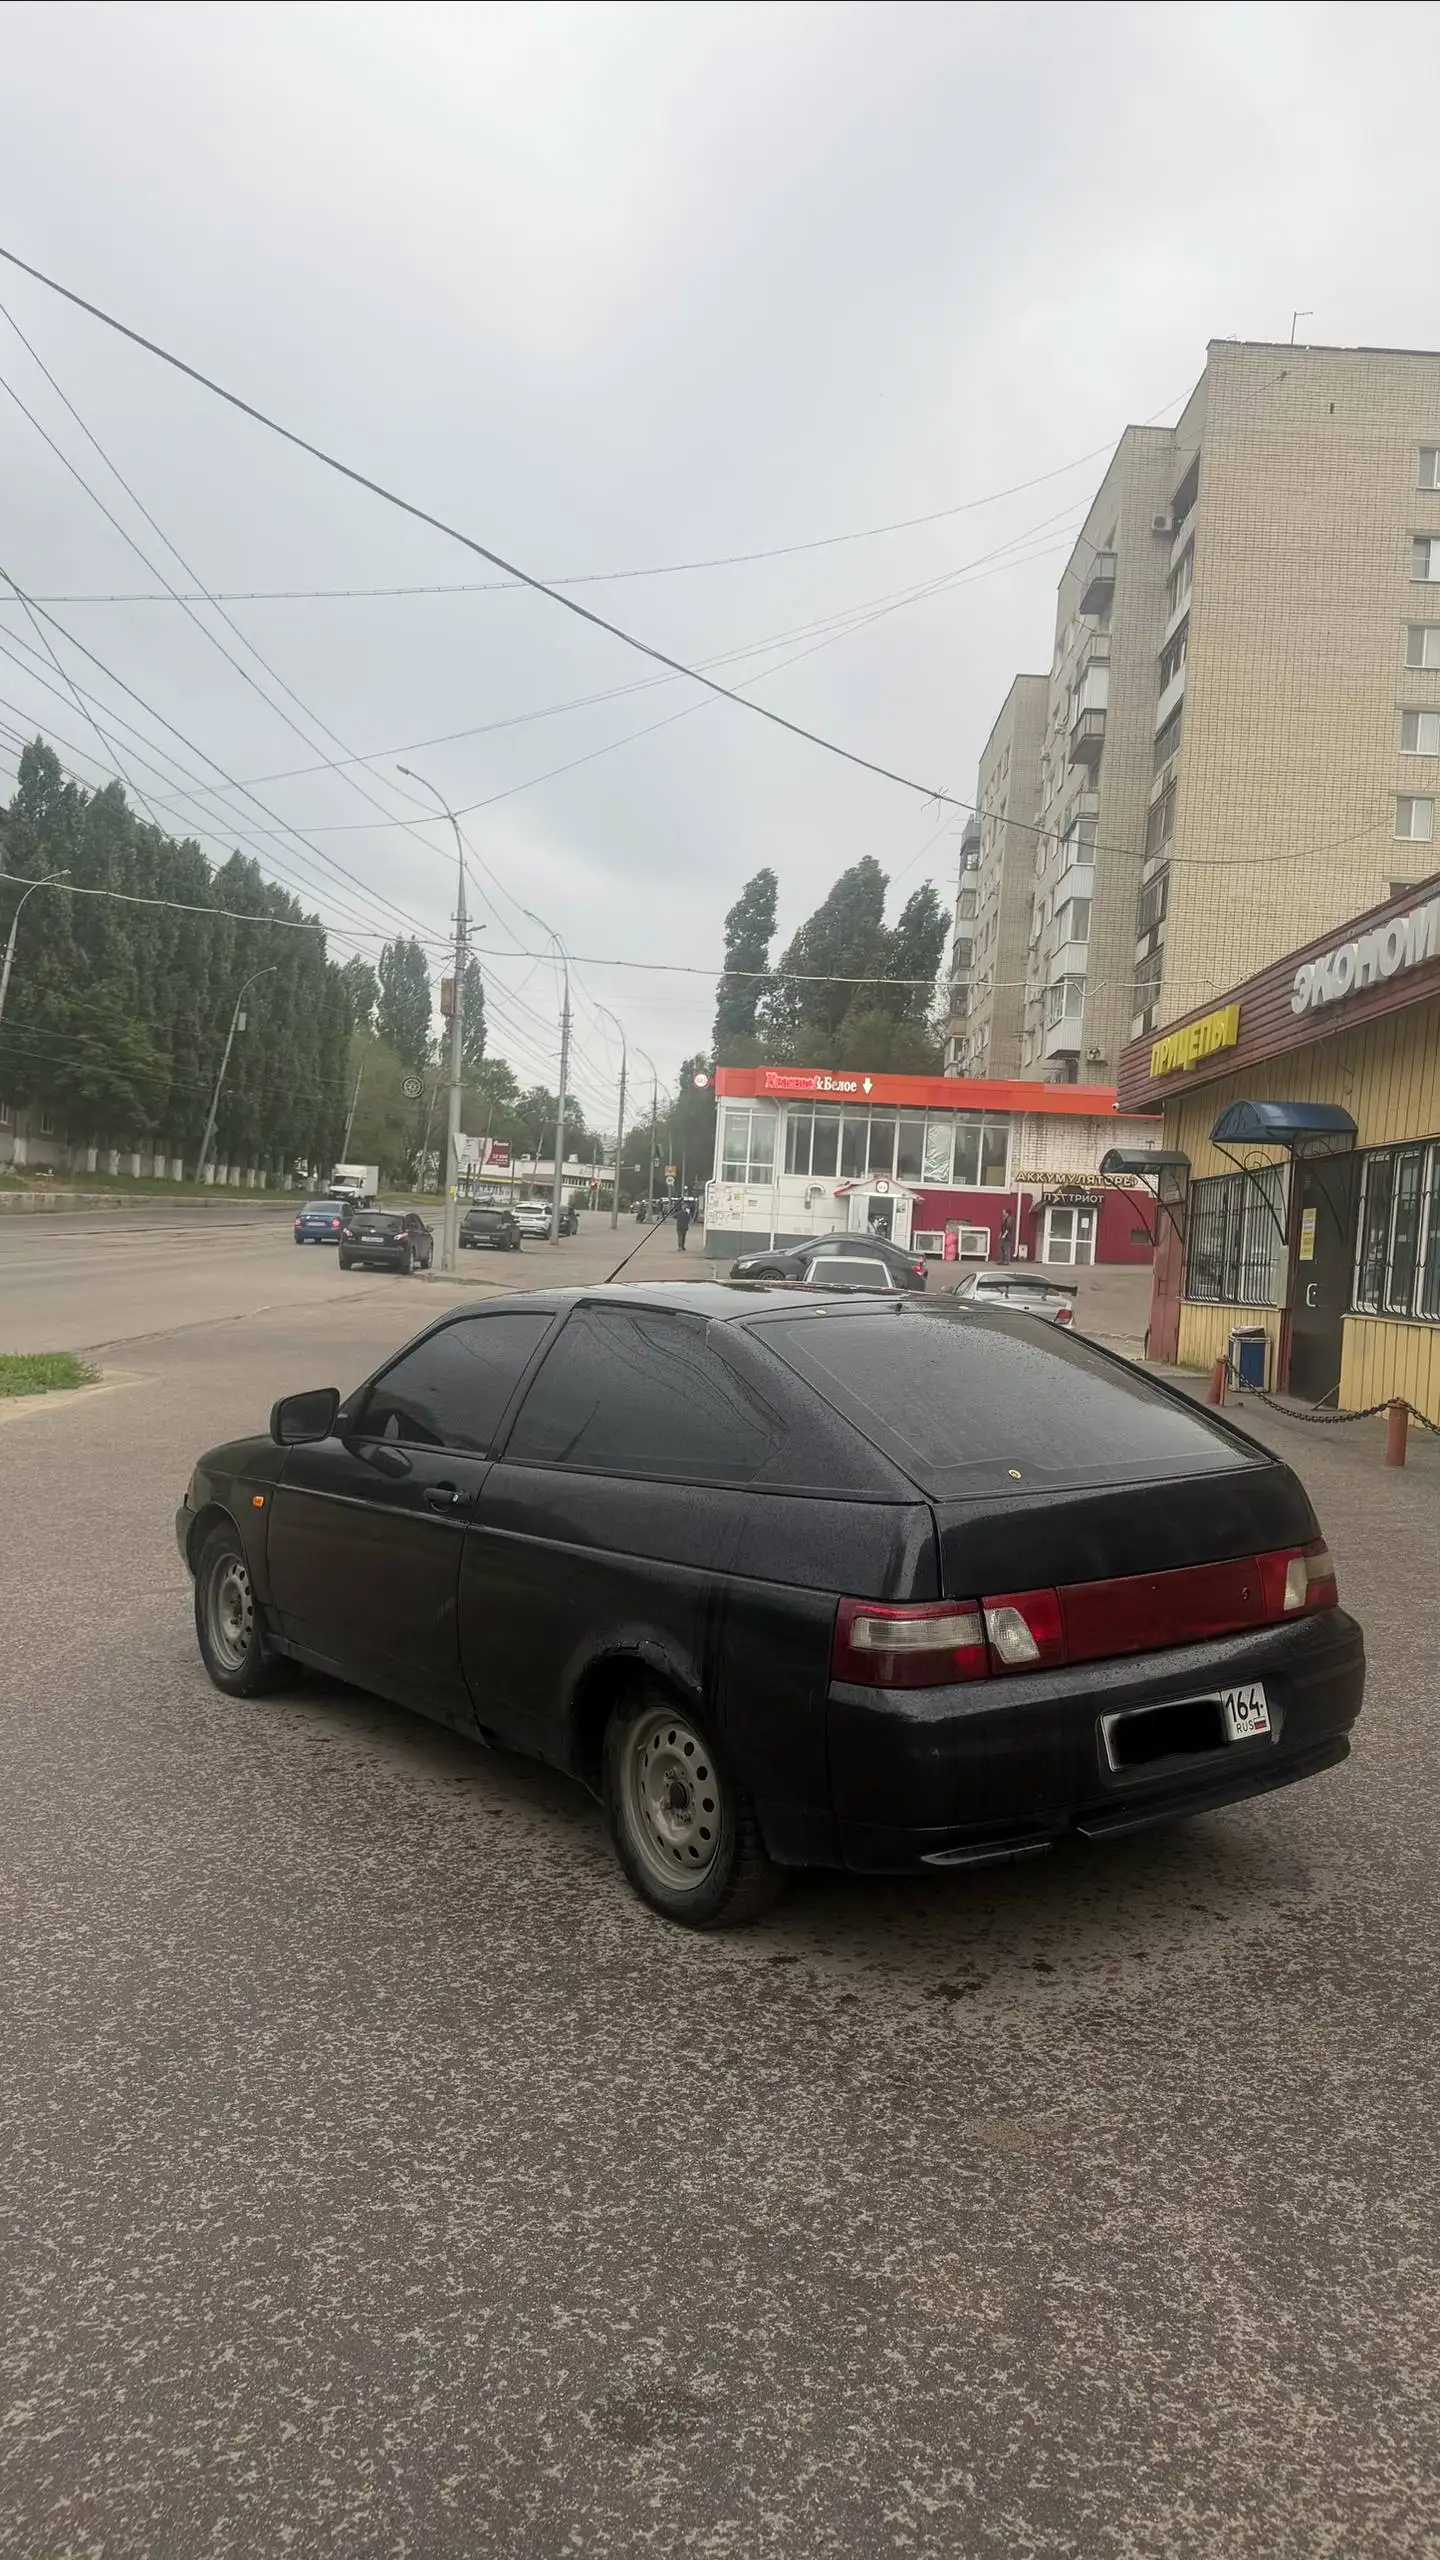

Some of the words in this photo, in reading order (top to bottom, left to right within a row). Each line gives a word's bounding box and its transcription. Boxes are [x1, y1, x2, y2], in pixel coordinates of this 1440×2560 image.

[1291, 896, 1440, 1014] ЭКОНОМ
[1150, 1004, 1240, 1078] ПРИЦЕПЫ
[1016, 1170, 1138, 1188] АККУМУЛЯТОРЫ
[1225, 1688, 1261, 1722] 164
[1236, 1719, 1254, 1733] RUS
